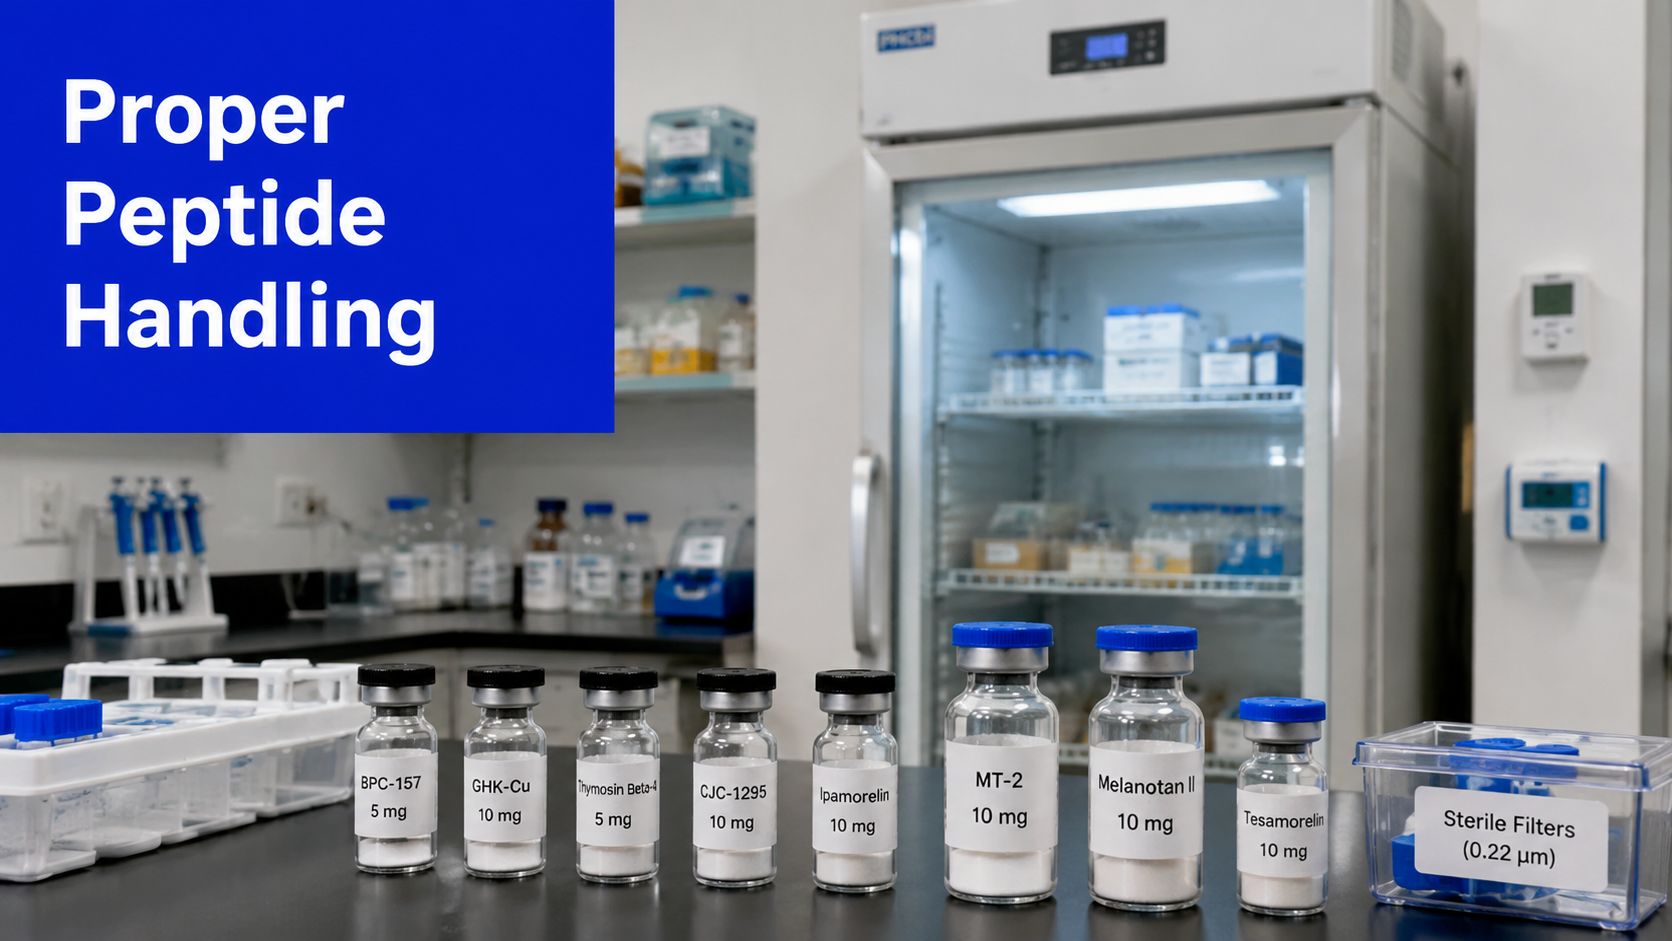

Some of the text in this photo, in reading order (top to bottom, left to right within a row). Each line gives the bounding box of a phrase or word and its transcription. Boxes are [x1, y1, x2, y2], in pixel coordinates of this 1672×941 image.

[361, 775, 422, 791] BPC-157
[472, 778, 531, 794] GHK-Cu
[627, 779, 657, 796] Beta-4
[976, 771, 1023, 789] MT-2
[1098, 773, 1185, 796] Melanotan
[700, 784, 767, 801] CJC-1295
[820, 786, 890, 804] Ipamorelin
[371, 803, 407, 822] 5 mg
[478, 807, 522, 826] 10 mg
[595, 811, 632, 830] 5 mg
[972, 806, 1028, 829] 10 mg
[1243, 810, 1325, 829] Tesamorelin
[710, 814, 754, 833] 10 mg
[830, 818, 876, 837] 10 mg
[1117, 812, 1174, 836] 10 mg
[1443, 809, 1576, 839] Sterile Filters
[1259, 842, 1308, 862] 10 mg
[1463, 840, 1556, 870] (0.22 µm)
